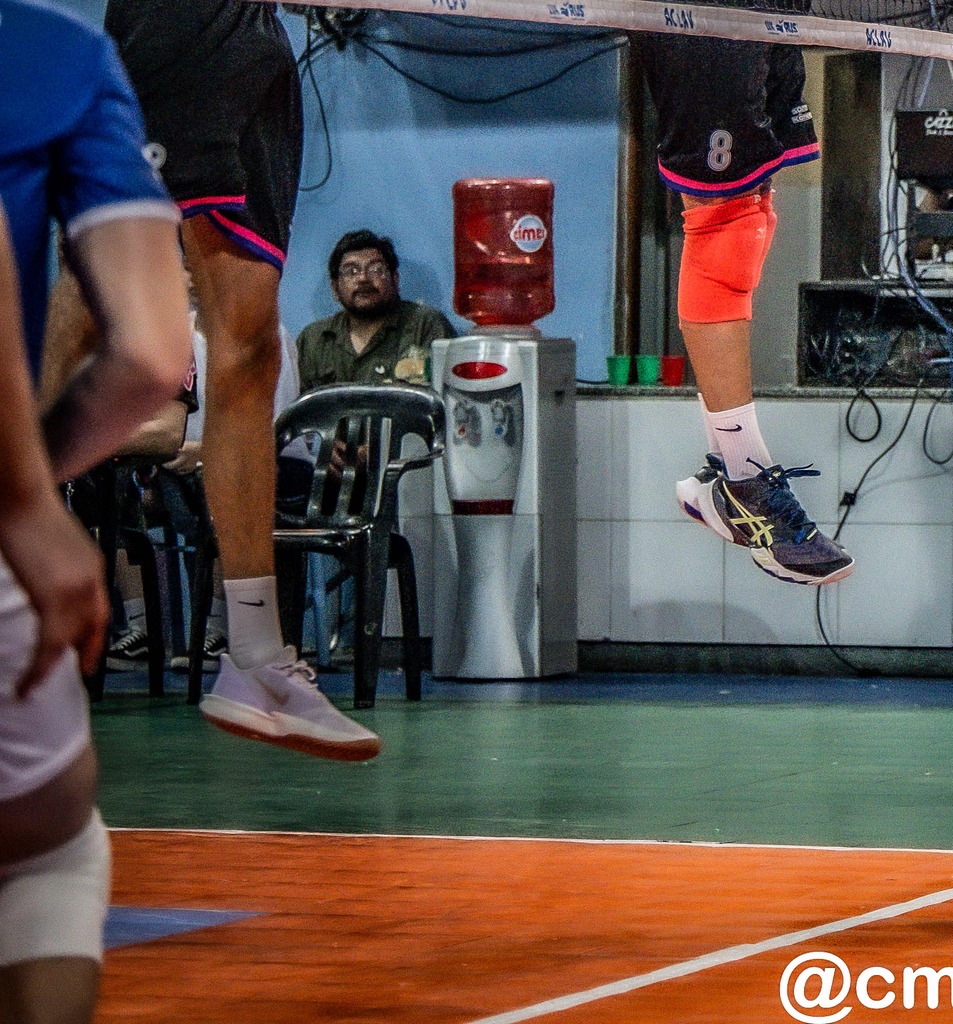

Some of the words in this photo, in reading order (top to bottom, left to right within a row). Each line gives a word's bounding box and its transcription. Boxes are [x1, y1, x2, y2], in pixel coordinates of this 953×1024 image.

[568, 5, 585, 18] RUS
[664, 7, 695, 29] ACLAV
[783, 22, 799, 35] RUS
[707, 129, 733, 172] 8
